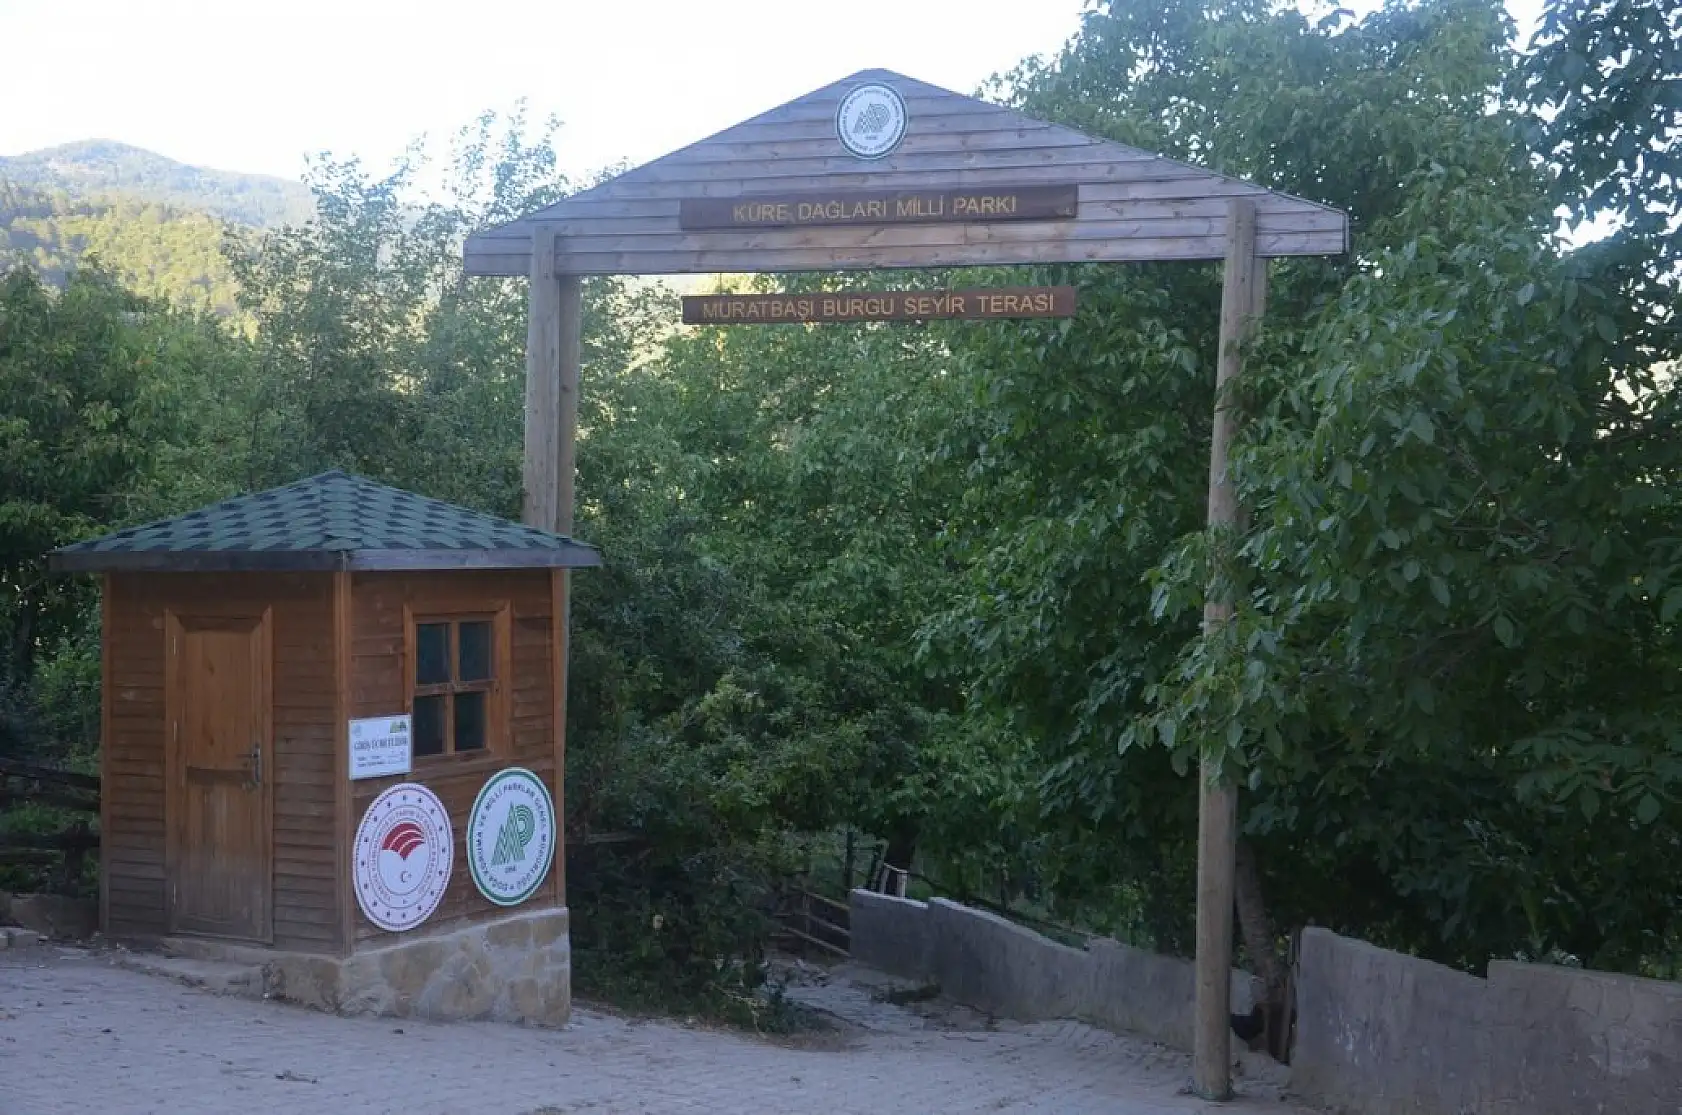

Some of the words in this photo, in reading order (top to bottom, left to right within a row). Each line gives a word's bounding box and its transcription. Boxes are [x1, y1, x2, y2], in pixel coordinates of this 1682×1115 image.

[799, 199, 887, 221] DAĞLARI
[896, 194, 944, 217] MİLLİ
[953, 195, 1017, 216] PARKI
[703, 299, 815, 320] MURATBAŞI
[823, 298, 895, 317] BURGU
[904, 293, 966, 316] SEYİR
[975, 293, 1054, 314] TERASI
